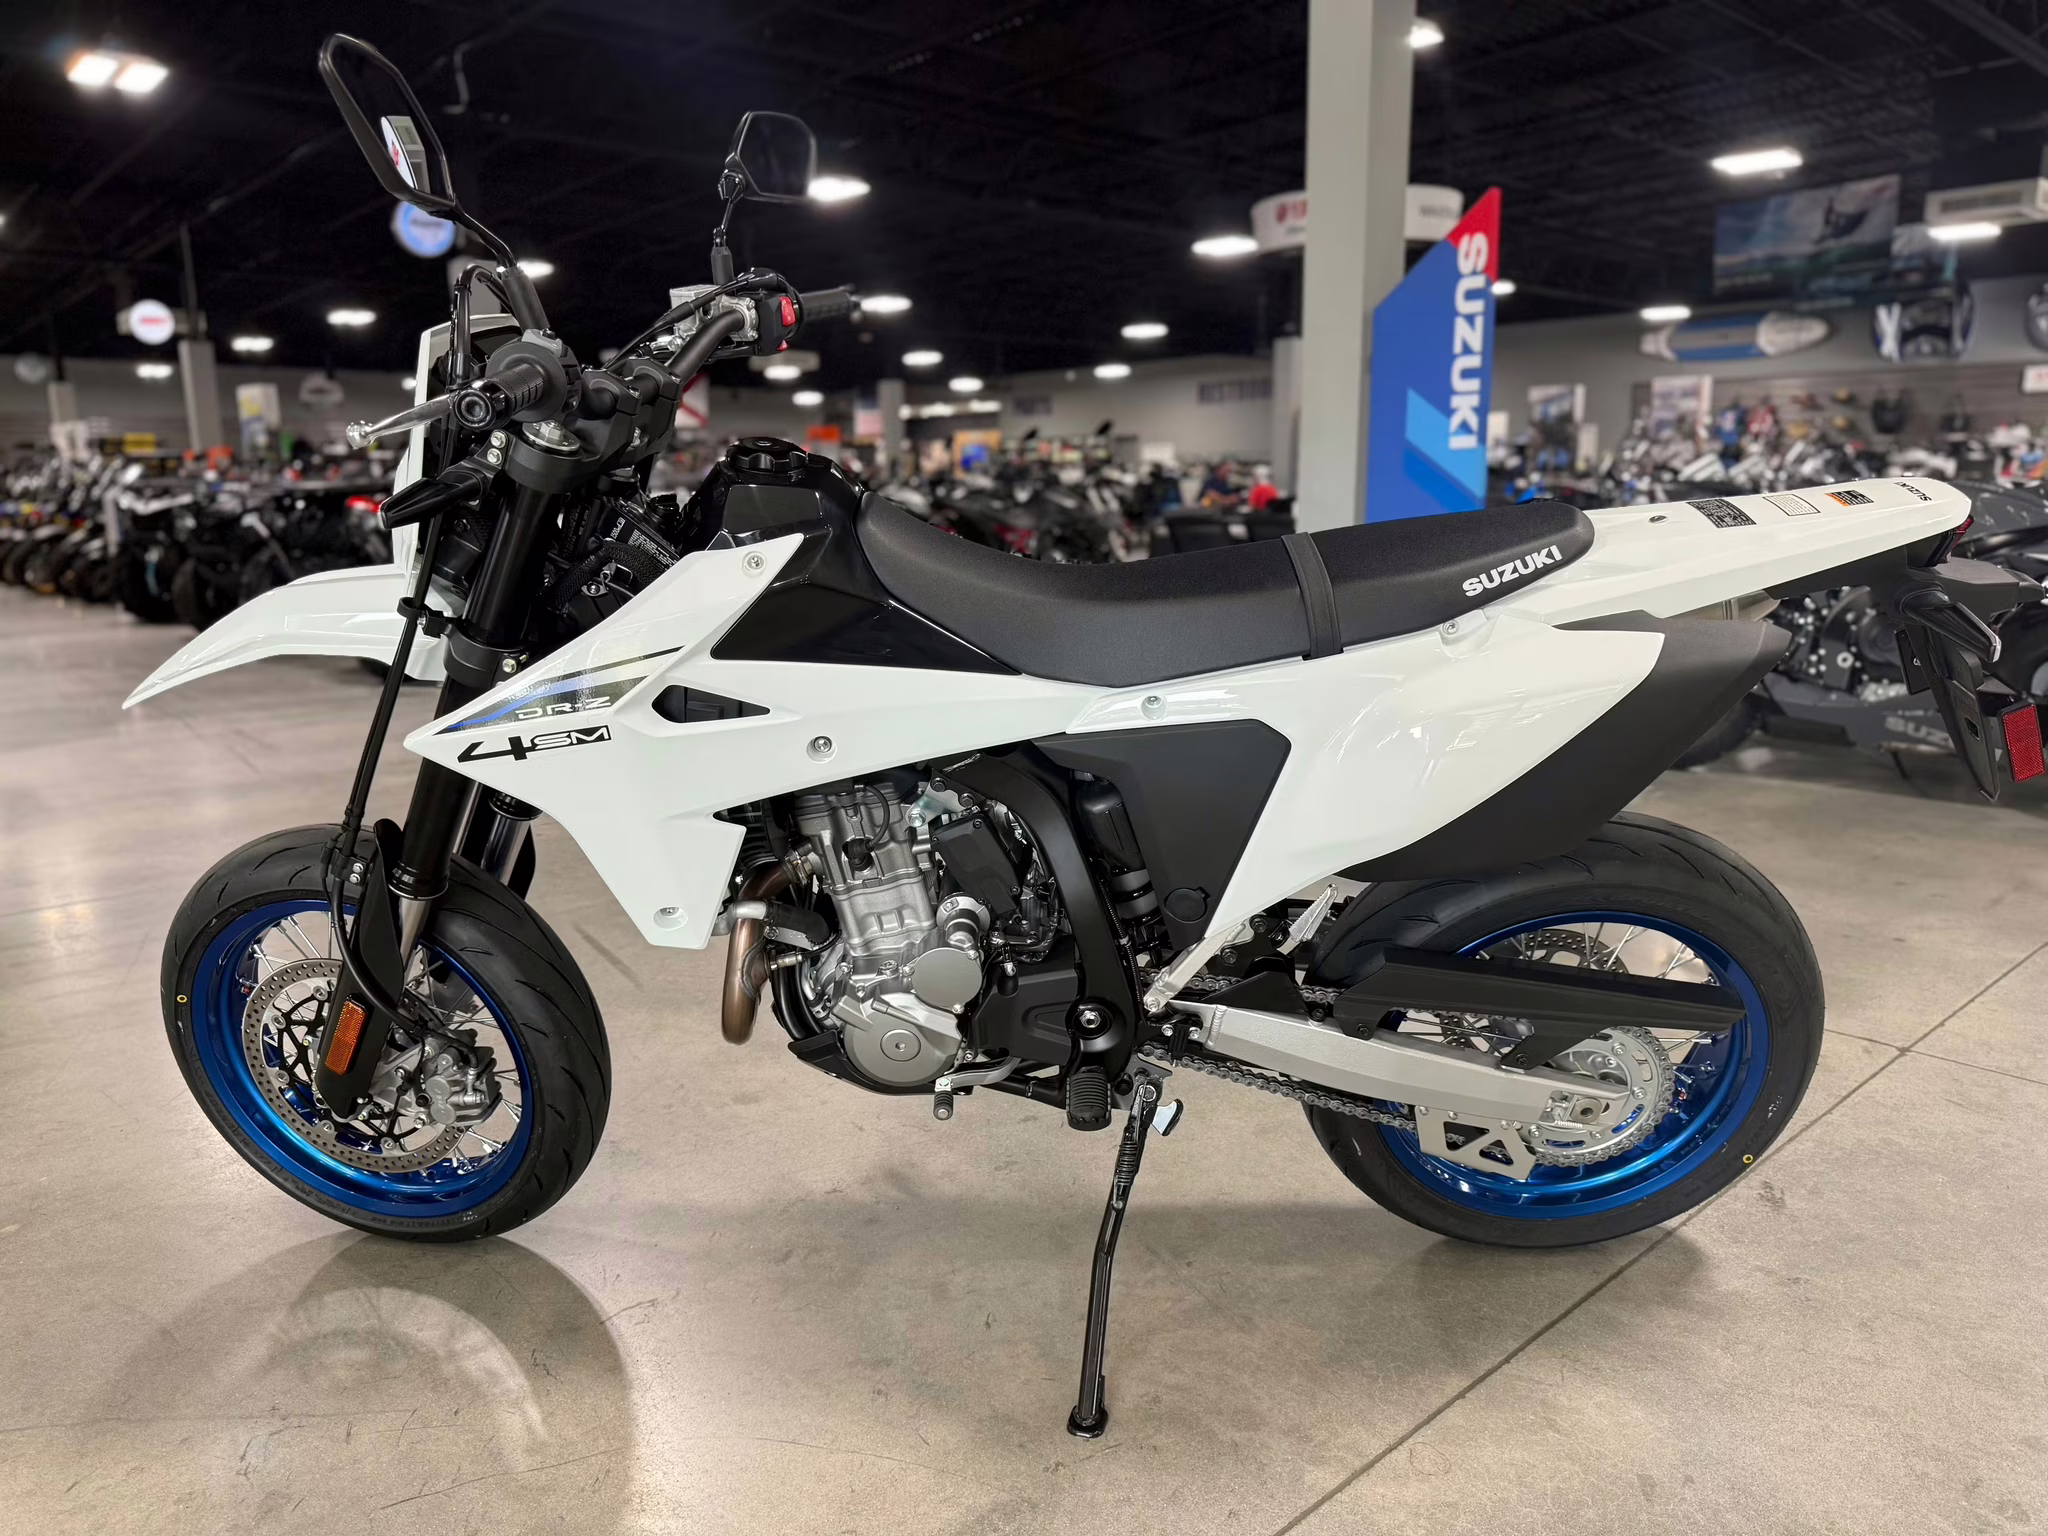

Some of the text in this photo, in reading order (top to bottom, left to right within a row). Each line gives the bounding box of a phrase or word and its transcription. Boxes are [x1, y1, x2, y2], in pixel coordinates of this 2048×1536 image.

[1449, 232, 1488, 449] SUZUKI
[1894, 482, 1932, 501] SUZUKI
[1463, 545, 1563, 597] SUZUKI
[515, 696, 612, 720] DR-Z
